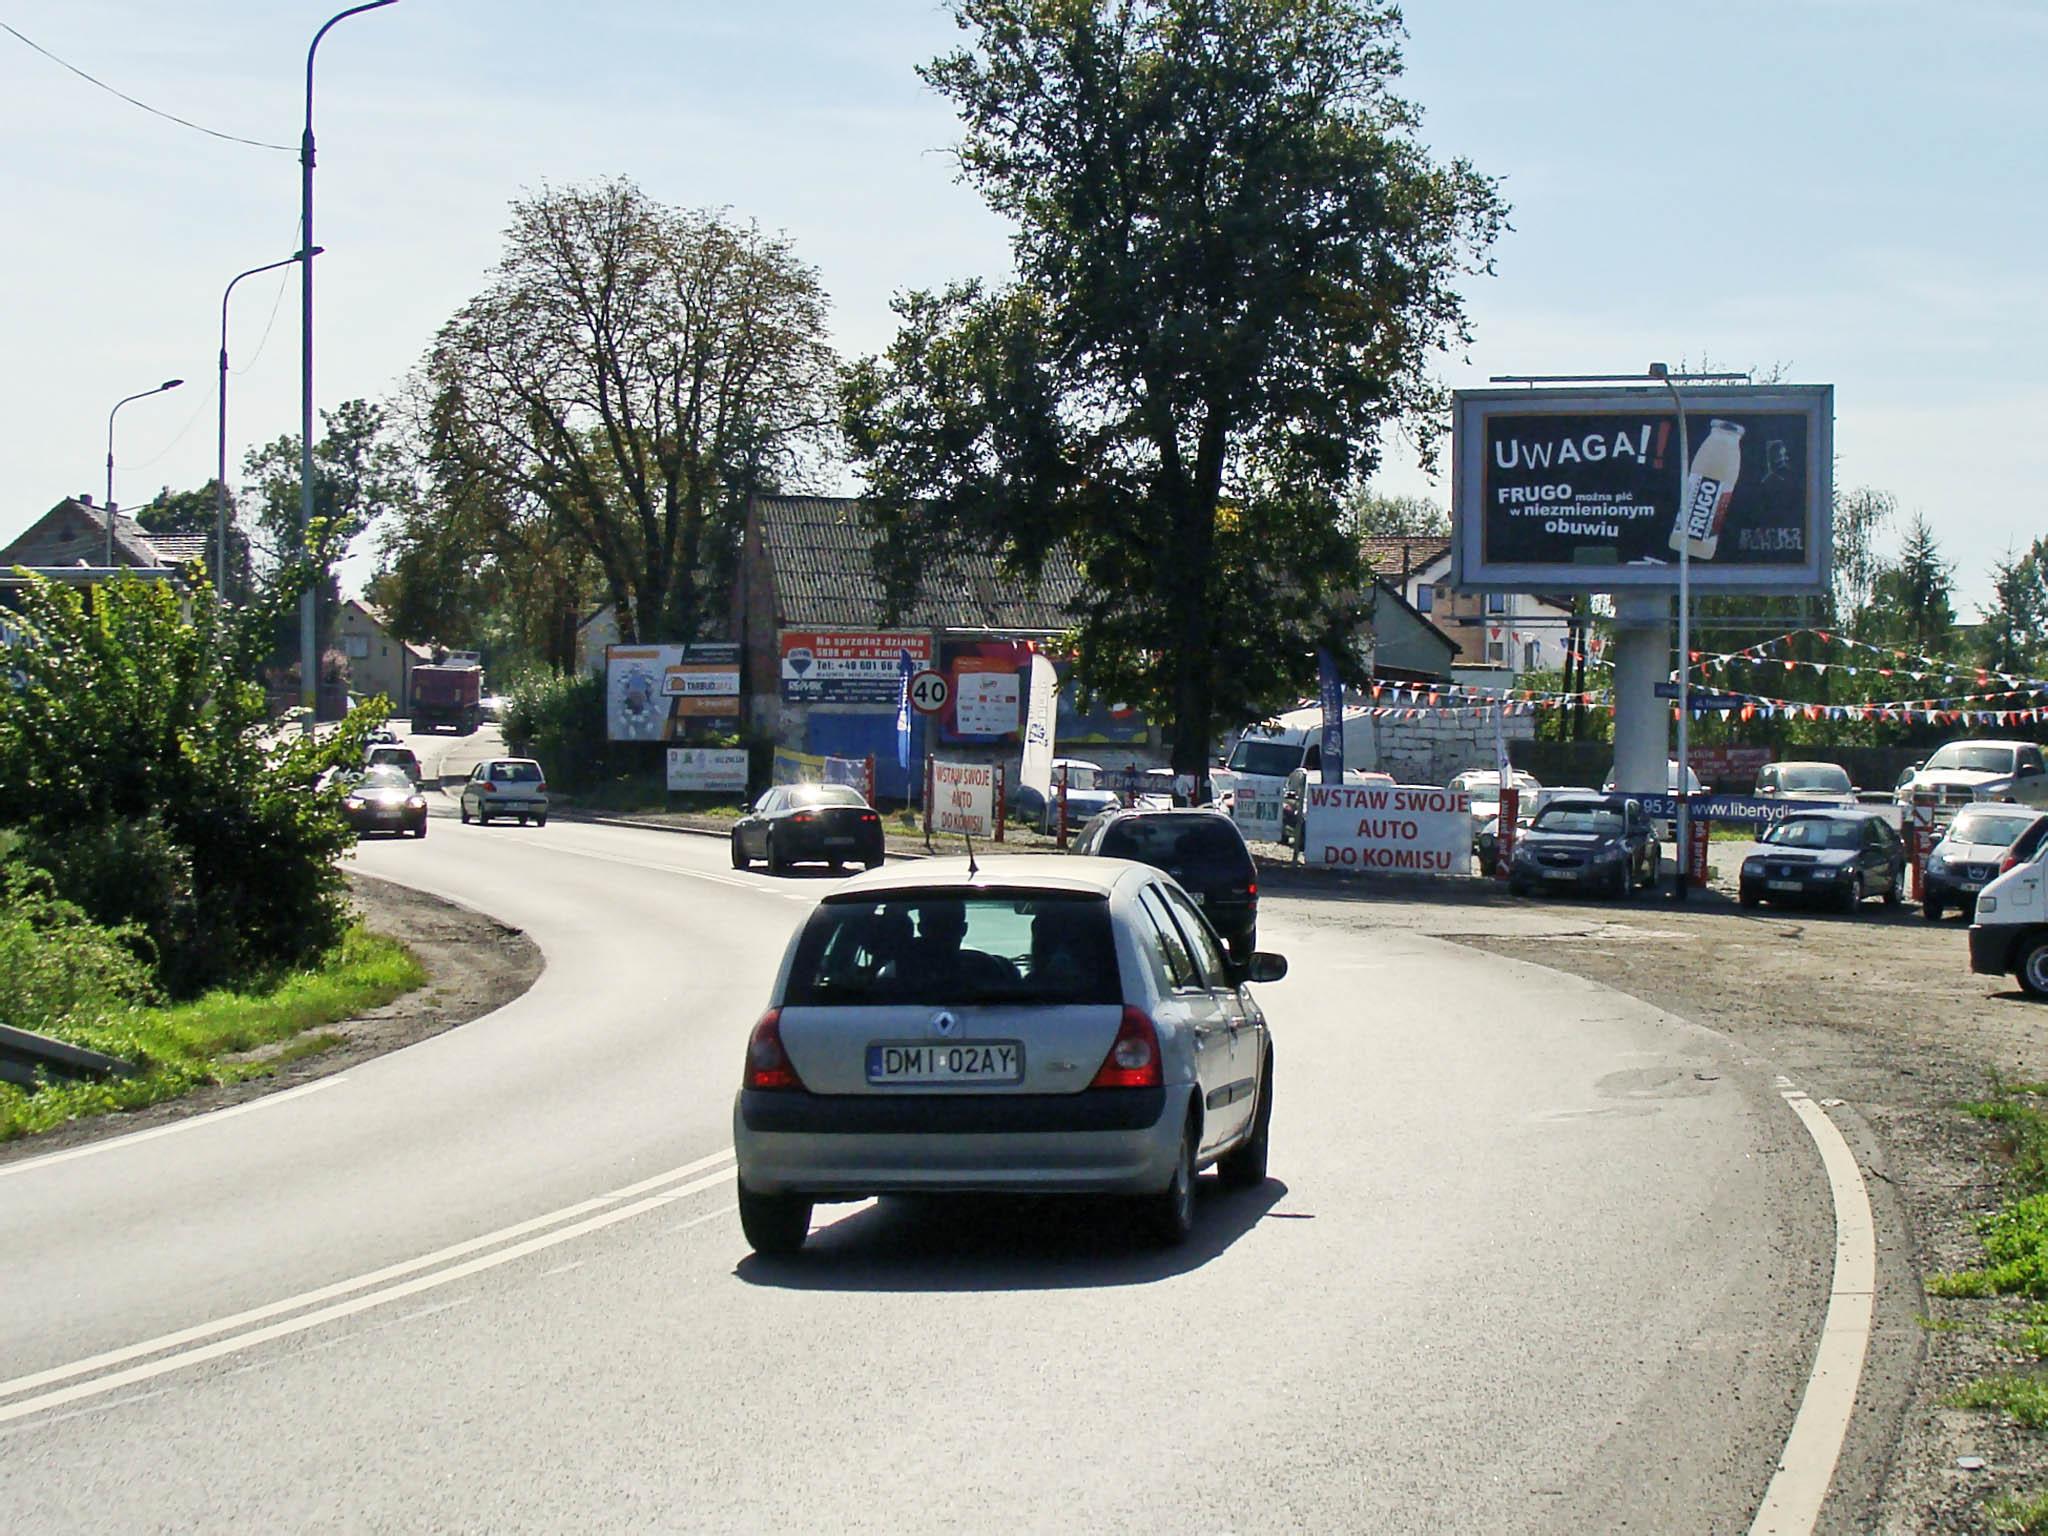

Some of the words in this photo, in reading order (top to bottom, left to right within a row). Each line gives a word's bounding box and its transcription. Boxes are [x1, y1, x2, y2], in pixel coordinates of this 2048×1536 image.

[1498, 484, 1573, 504] FRUGO
[1509, 507, 1521, 516] w
[1524, 502, 1655, 519] niezmienionym
[1688, 481, 1718, 538] FRUGO
[1544, 518, 1619, 537] obuwiu
[816, 637, 830, 646] Na
[834, 637, 881, 647] sprzedaż
[884, 637, 925, 647] działka
[816, 661, 834, 670] Tel:
[914, 681, 945, 703] 40
[936, 765, 963, 783] WSTAW
[963, 768, 990, 786] SWOJE
[952, 790, 972, 808] AUTO
[1311, 787, 1391, 810] WSTAW
[1394, 791, 1470, 813] SWOJE
[941, 812, 953, 828] DO
[953, 815, 983, 833] KOMISU
[1357, 819, 1418, 840] AUTO
[1324, 846, 1357, 865] DO
[1363, 848, 1451, 869] KOMISU
[886, 1049, 934, 1073] DMI
[949, 1048, 1010, 1073] 02AY
